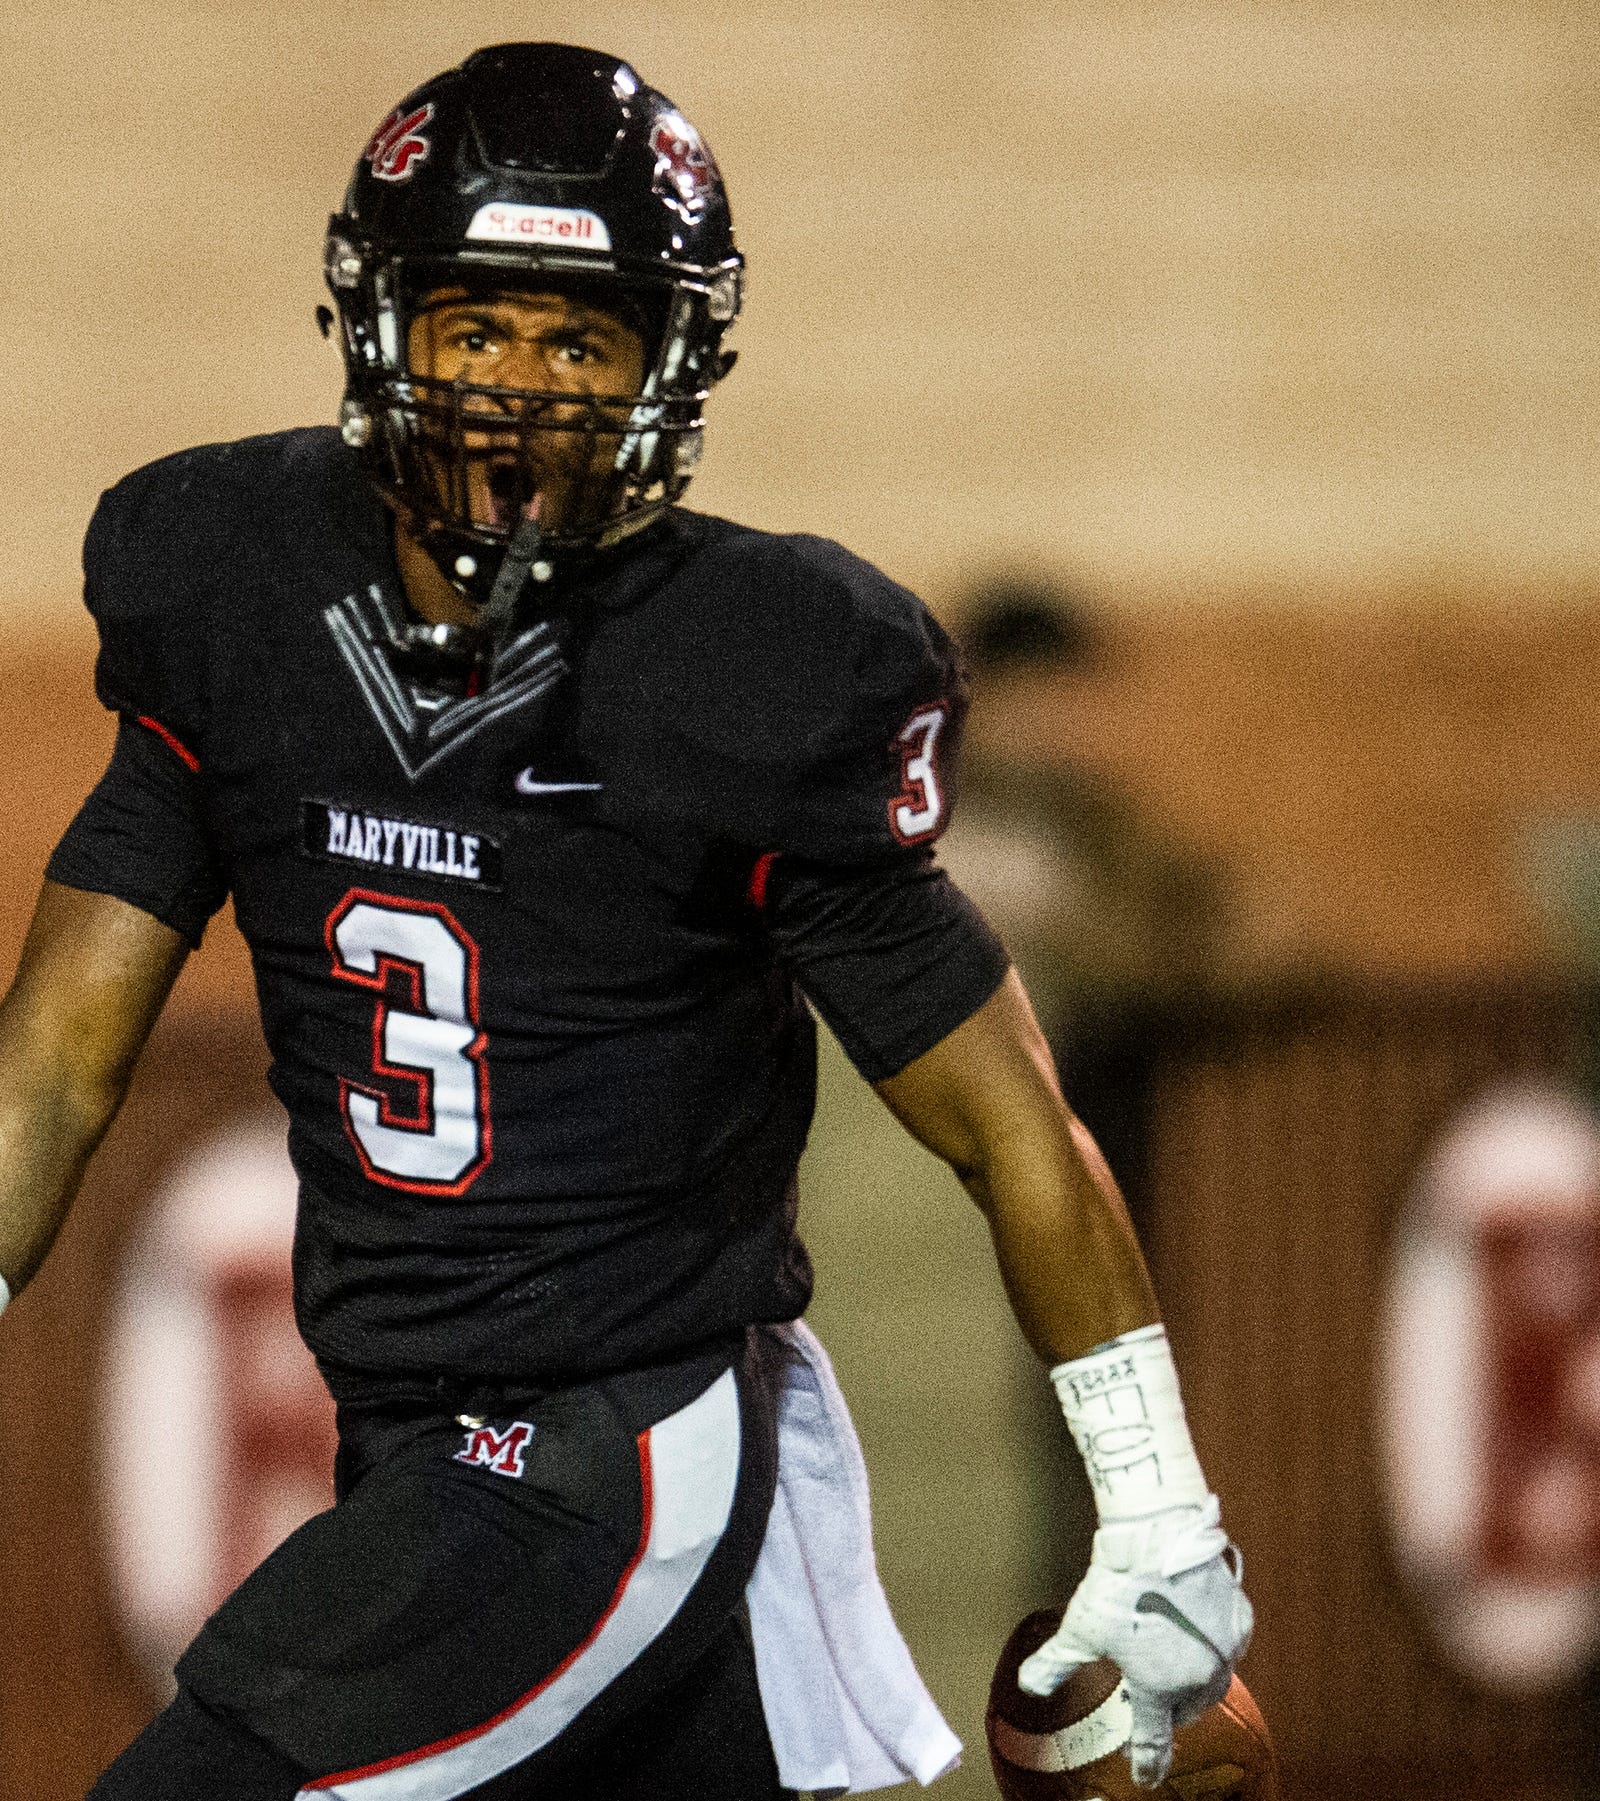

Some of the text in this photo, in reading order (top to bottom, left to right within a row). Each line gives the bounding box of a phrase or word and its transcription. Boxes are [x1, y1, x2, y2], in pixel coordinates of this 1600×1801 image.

[887, 698, 949, 847] 3
[326, 809, 481, 881] MARYVILLE
[324, 887, 493, 1197] 3
[452, 1421, 535, 1478] M
